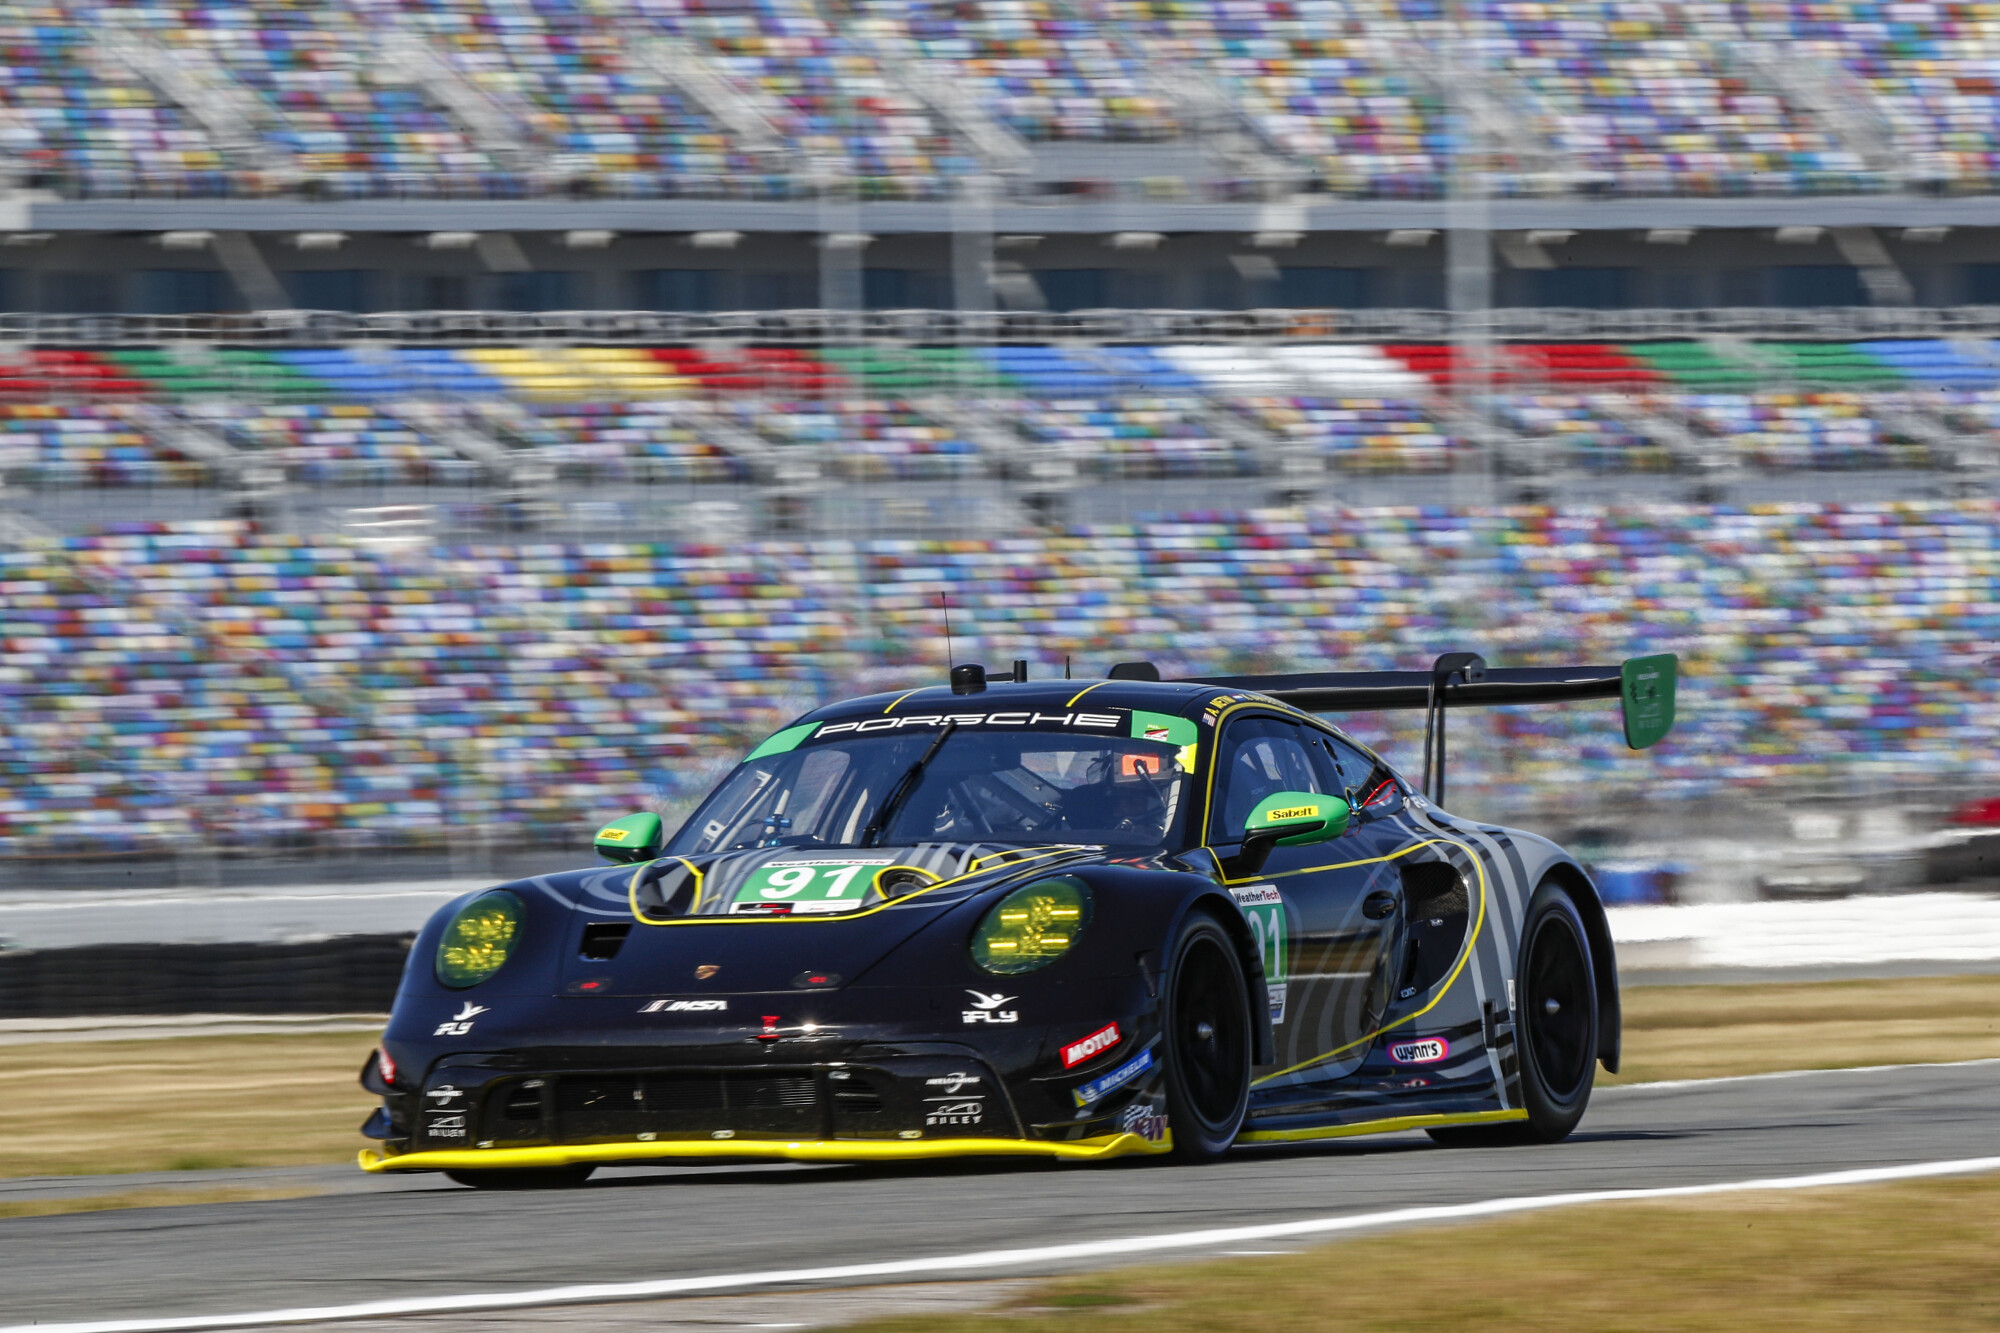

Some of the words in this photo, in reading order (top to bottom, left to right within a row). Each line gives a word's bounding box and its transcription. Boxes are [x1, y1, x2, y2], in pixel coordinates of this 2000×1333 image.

[814, 713, 1121, 738] PORSCHE
[1272, 807, 1313, 820] Sabelt
[759, 865, 864, 899] 91
[1233, 890, 1280, 903] WeatherTech
[664, 1001, 728, 1012] IMSA
[1067, 1025, 1119, 1065] MOTUL
